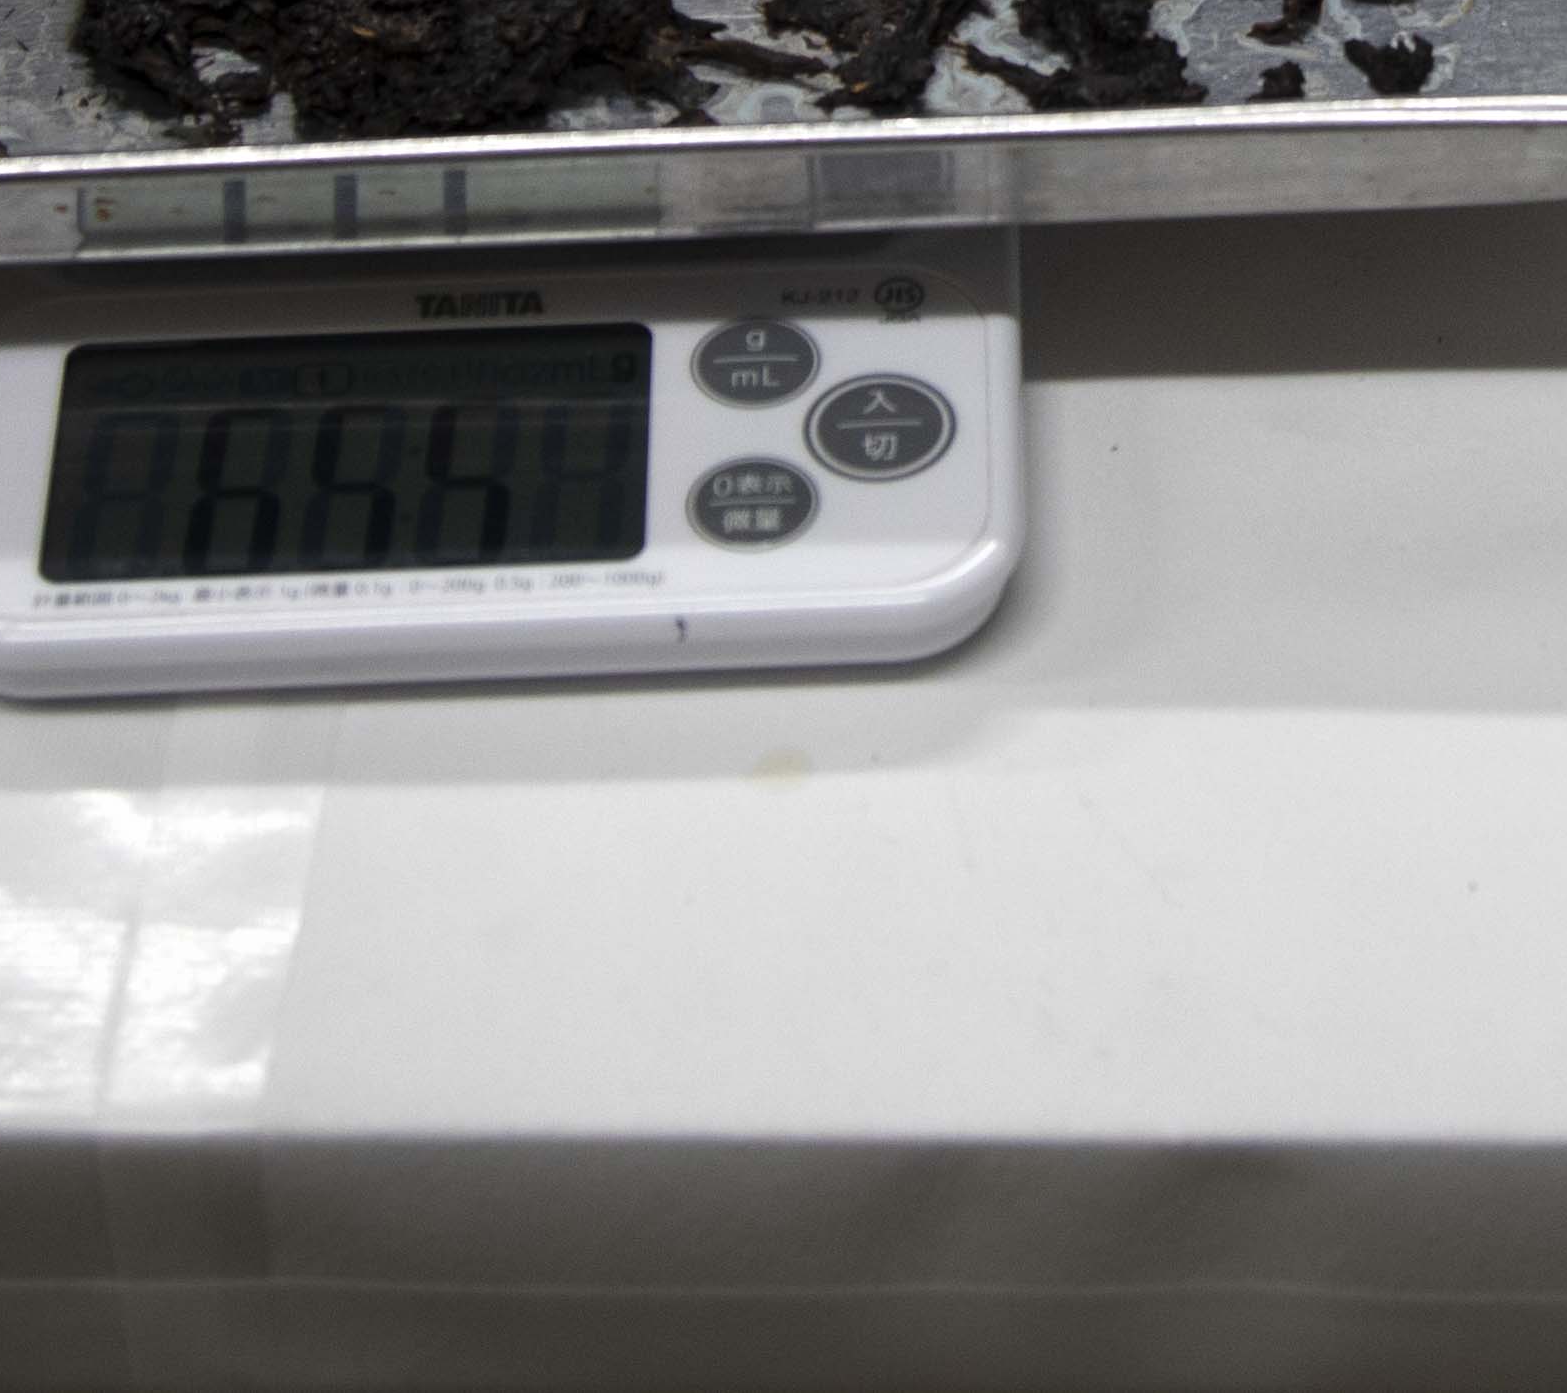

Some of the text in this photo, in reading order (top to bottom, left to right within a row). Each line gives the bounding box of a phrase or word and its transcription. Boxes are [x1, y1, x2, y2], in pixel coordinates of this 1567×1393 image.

[415, 290, 545, 321] TANITA
[745, 329, 766, 351] g
[731, 367, 779, 387] mL
[863, 390, 896, 414] 入
[864, 432, 898, 460] 切
